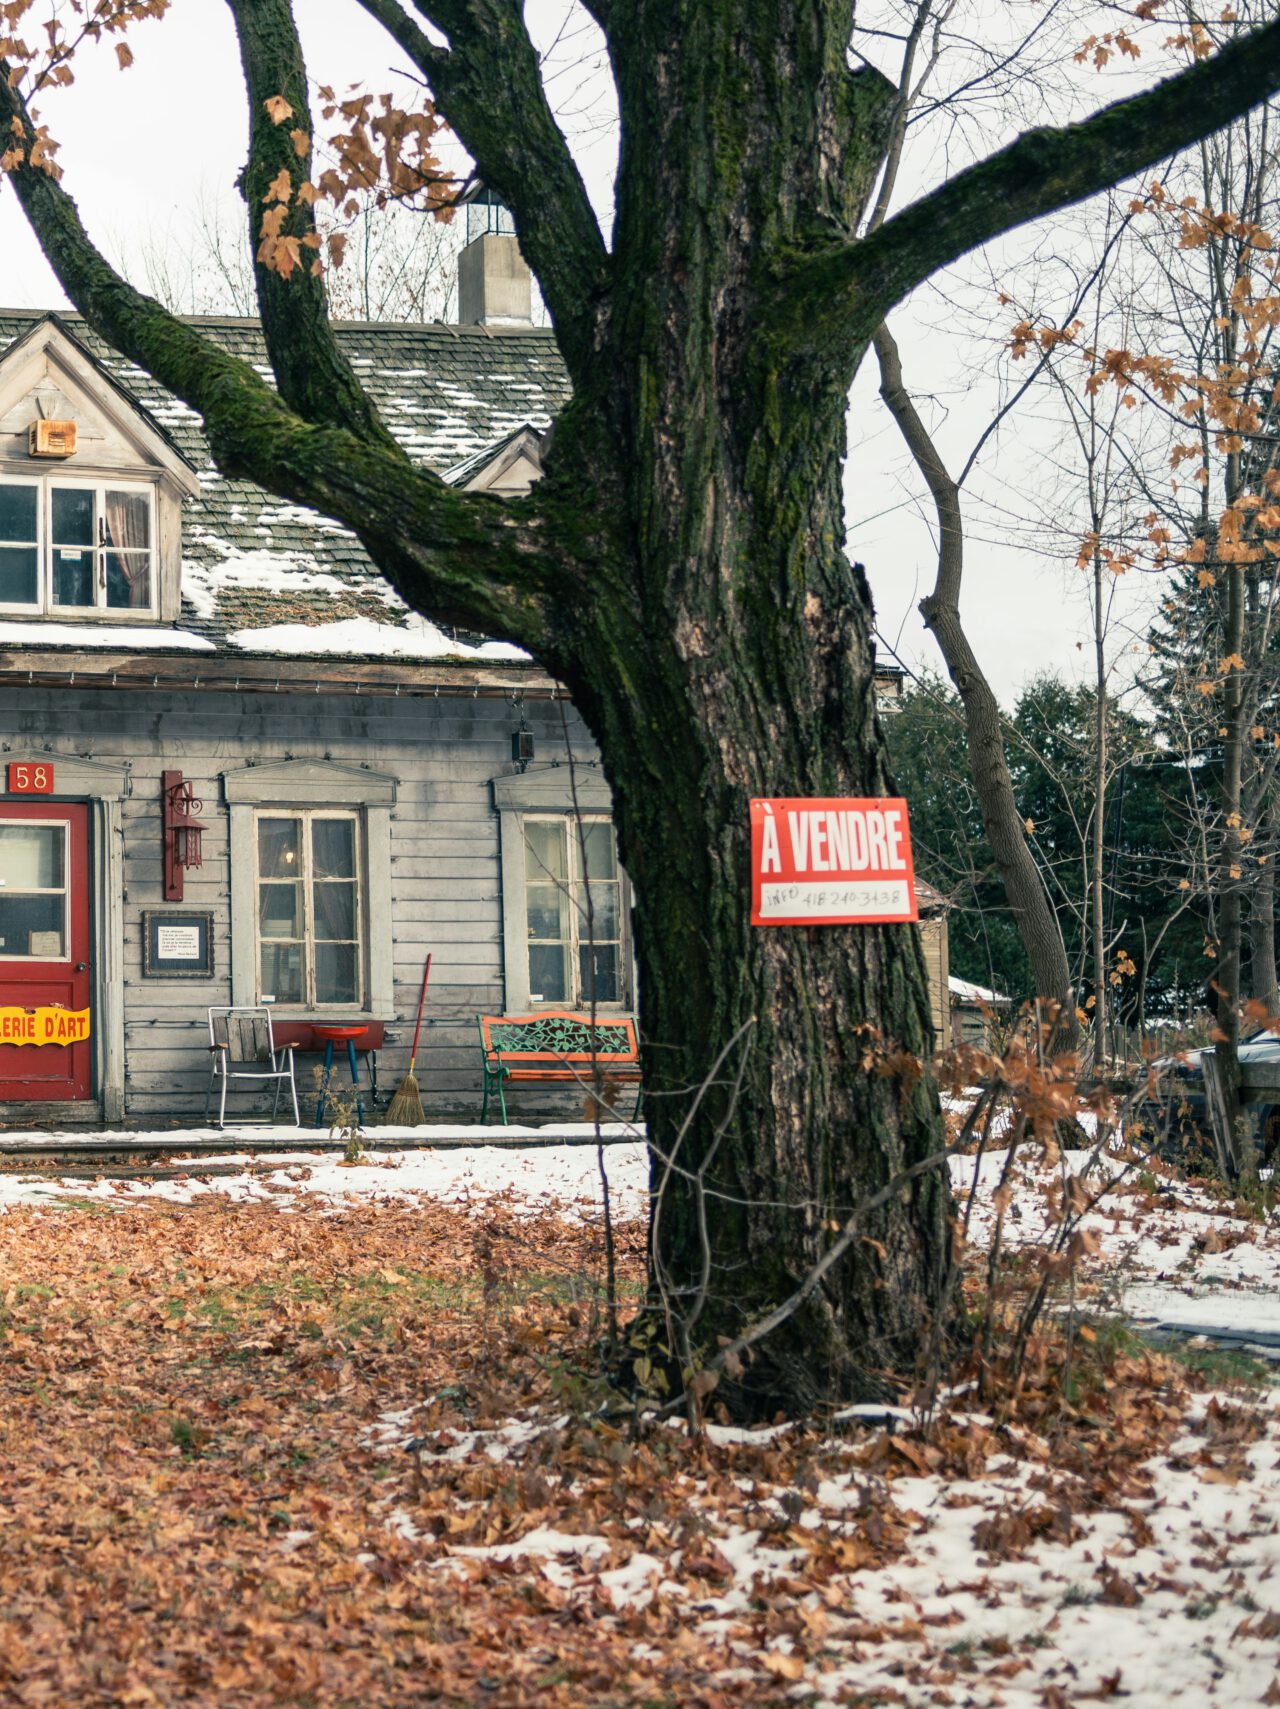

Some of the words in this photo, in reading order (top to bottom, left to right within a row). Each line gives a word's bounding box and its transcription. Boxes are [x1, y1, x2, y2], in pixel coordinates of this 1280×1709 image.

[16, 766, 47, 789] 58
[760, 802, 782, 873] À
[787, 810, 907, 872] VENDRE
[45, 1013, 86, 1038] D'ART
